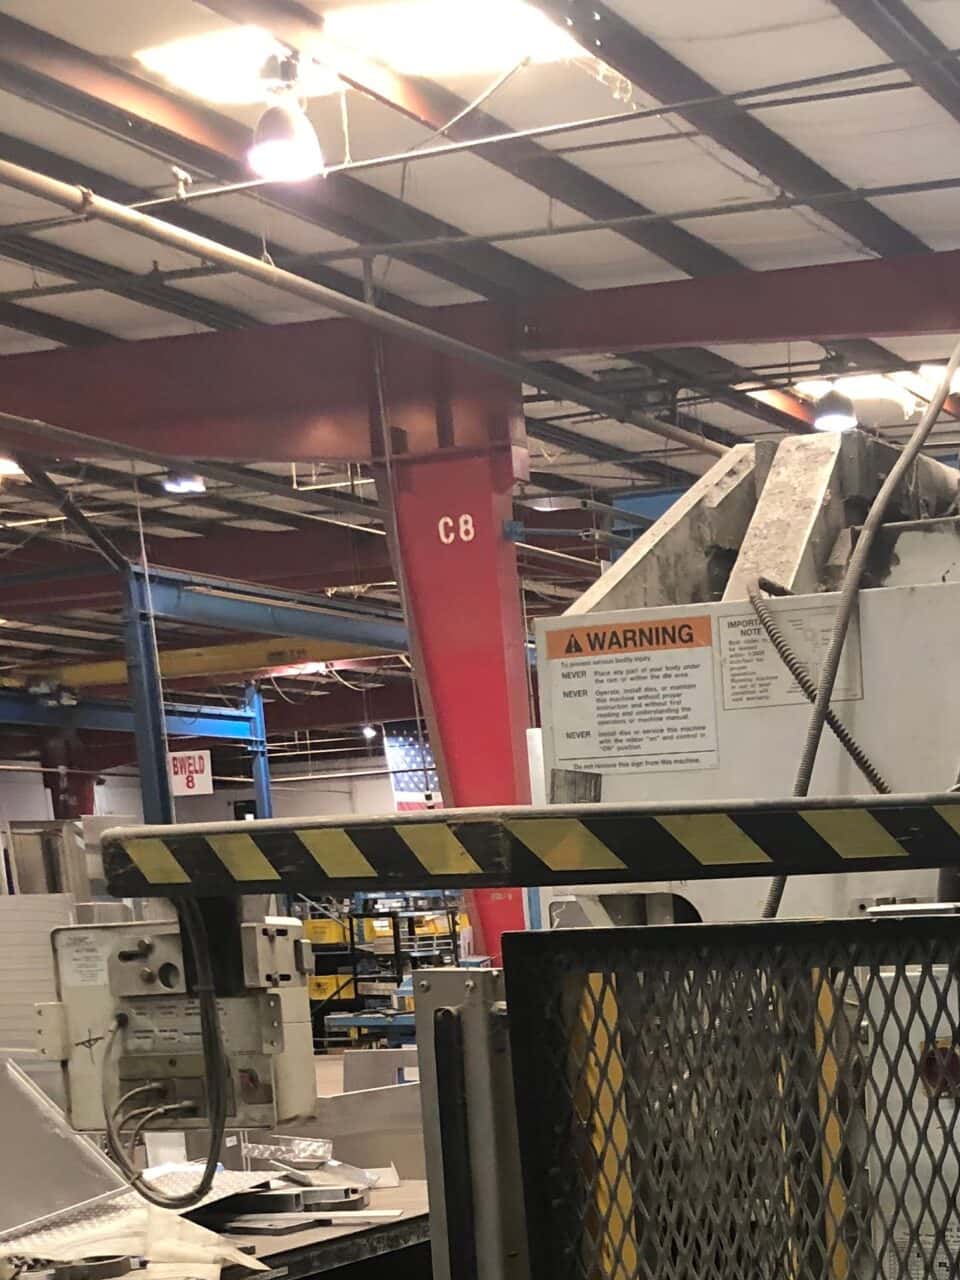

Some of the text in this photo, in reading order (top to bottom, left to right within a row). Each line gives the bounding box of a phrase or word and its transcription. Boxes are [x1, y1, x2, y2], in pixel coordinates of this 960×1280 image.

[438, 513, 475, 545] C8
[586, 624, 694, 651] WARNING
[561, 670, 587, 680] NEVER
[664, 664, 681, 672] body
[562, 689, 588, 699] NEVER
[566, 730, 591, 740] NEVER
[172, 754, 205, 776] BWELD
[185, 775, 195, 789] 8
